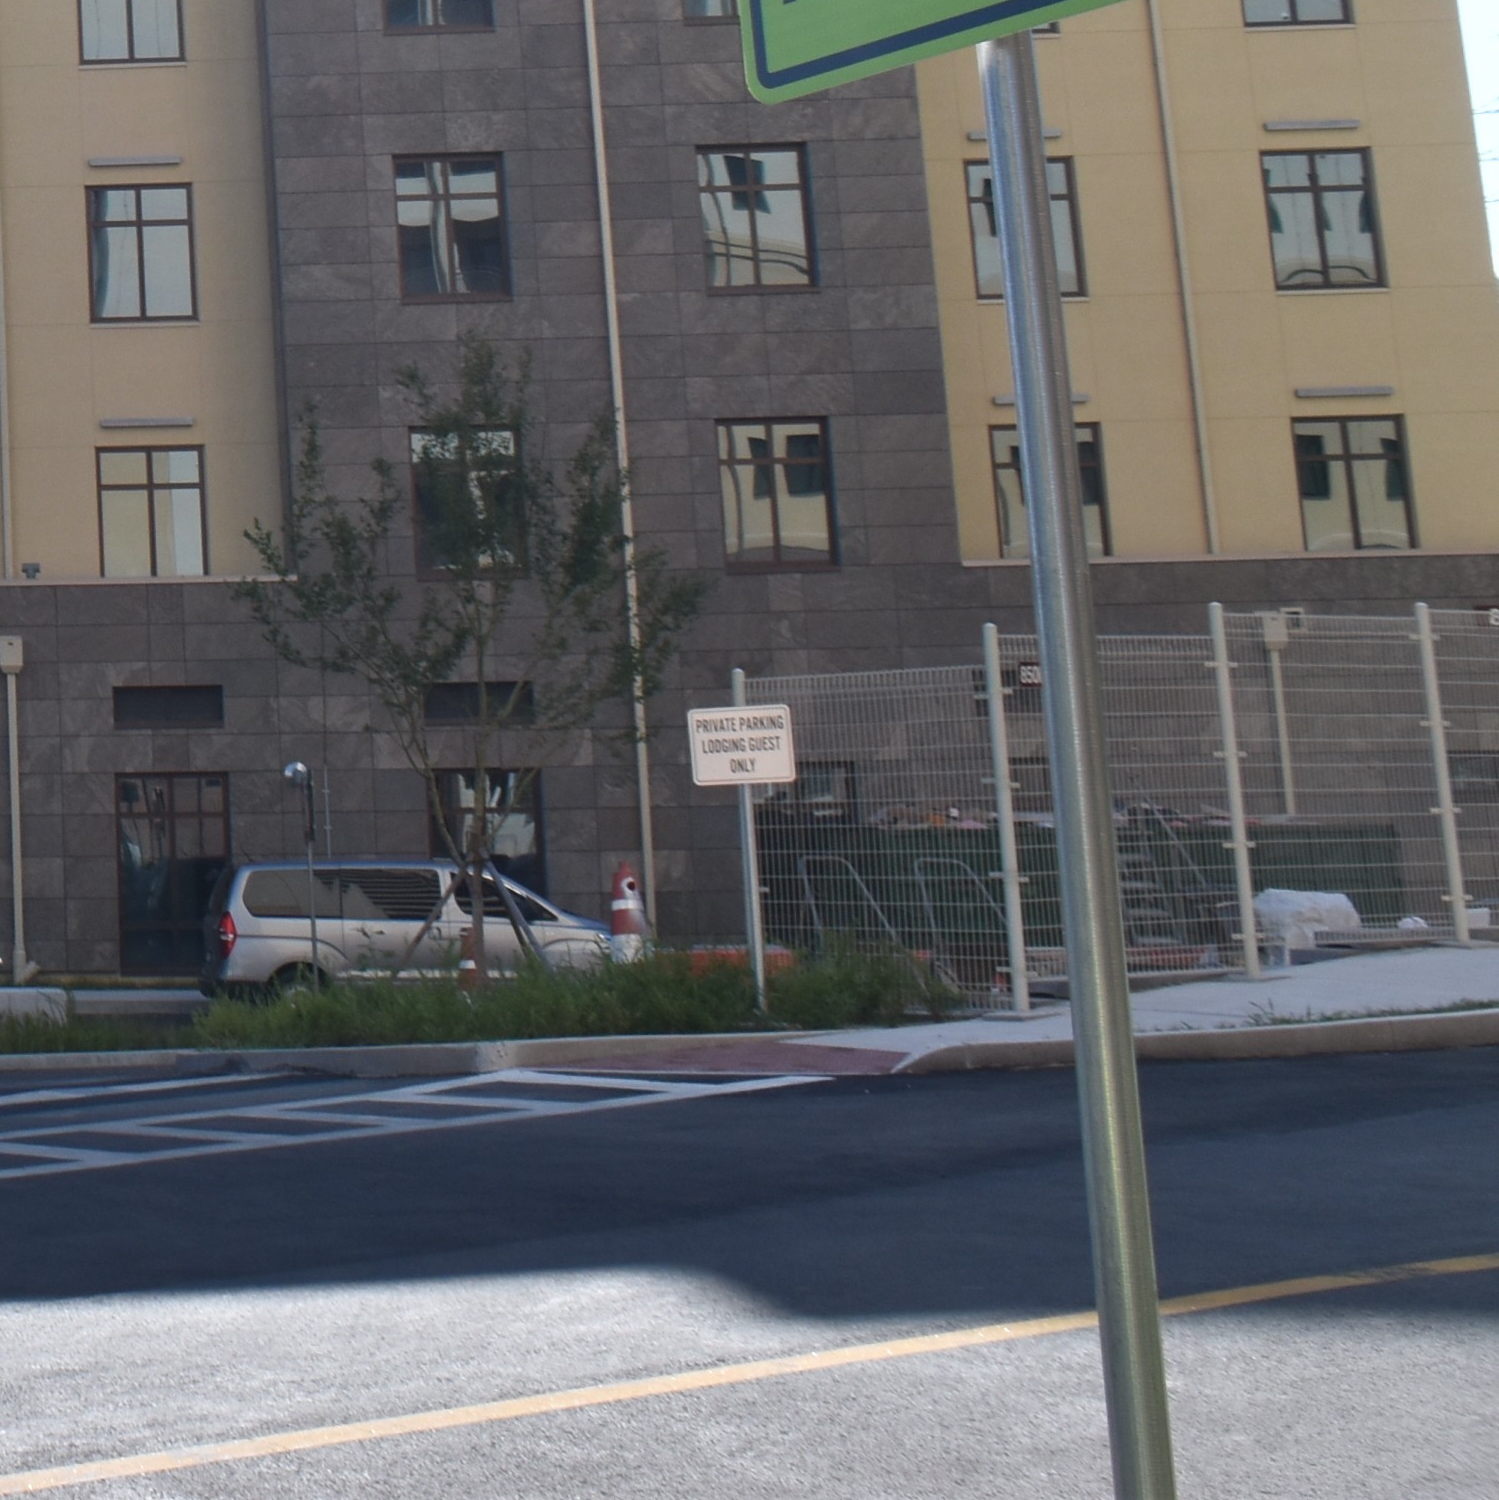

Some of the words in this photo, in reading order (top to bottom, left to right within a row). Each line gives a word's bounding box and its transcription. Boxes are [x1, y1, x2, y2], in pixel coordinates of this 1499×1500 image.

[695, 717, 737, 733] PRIVATE
[739, 715, 784, 731] PARKING
[701, 737, 746, 754] LODGING
[748, 736, 781, 752] GUEST
[730, 758, 755, 774] ONLY
